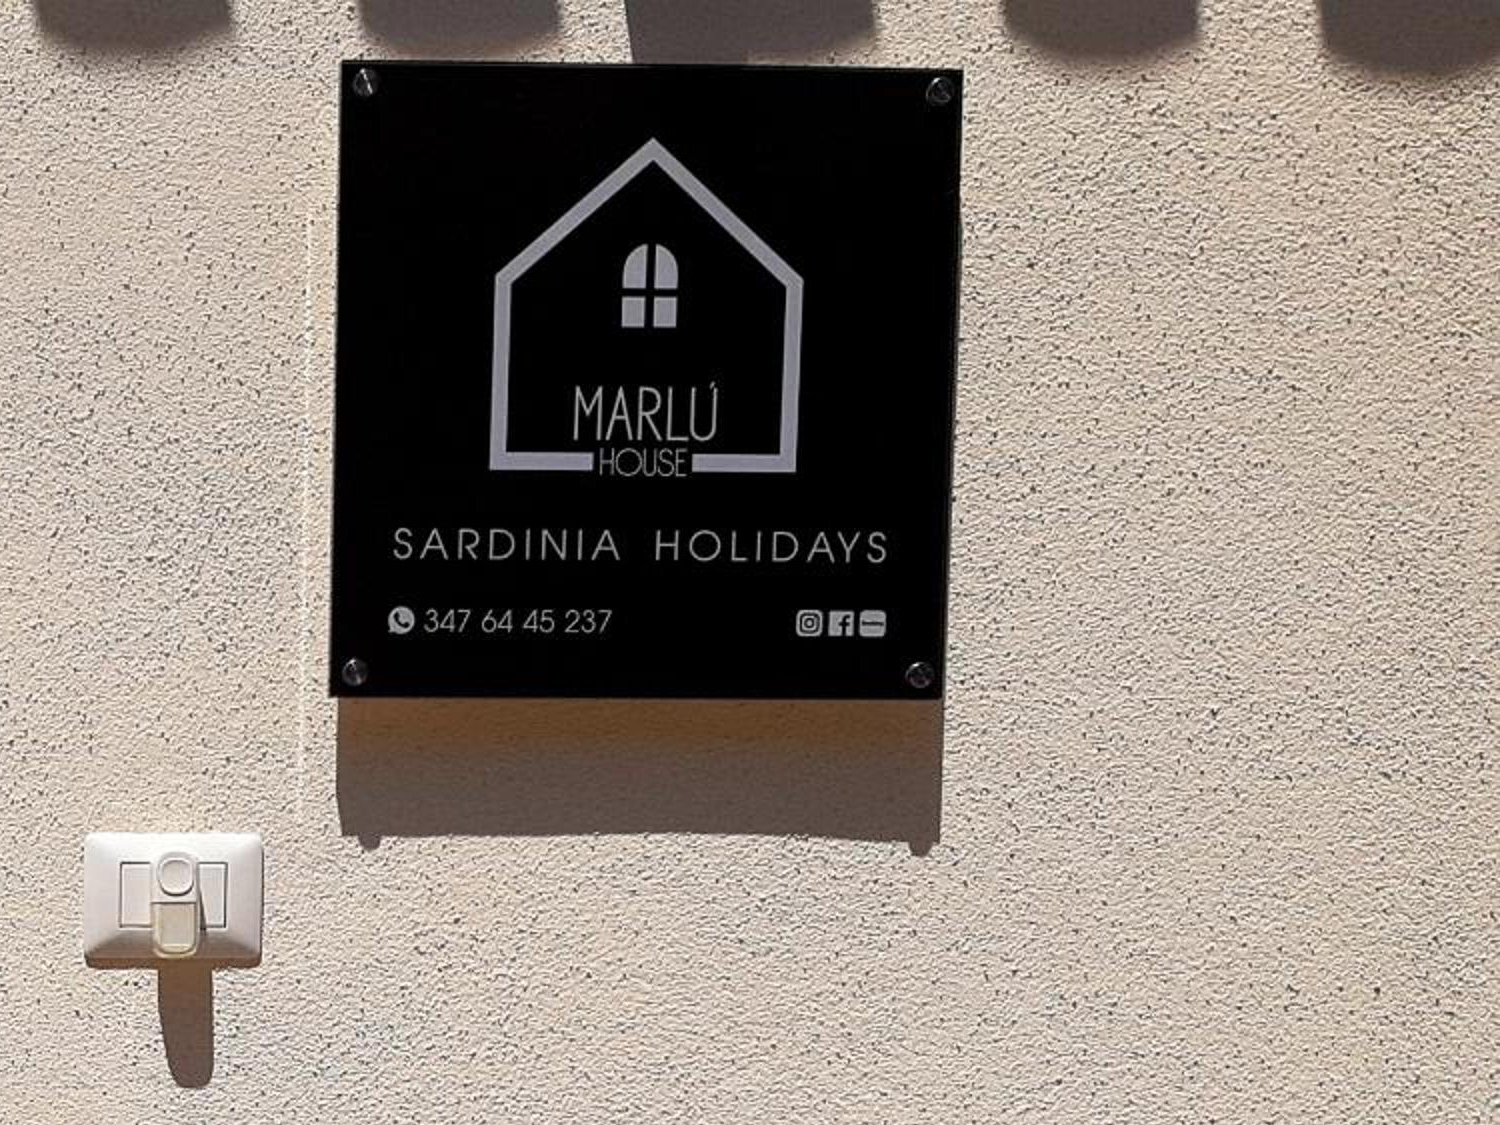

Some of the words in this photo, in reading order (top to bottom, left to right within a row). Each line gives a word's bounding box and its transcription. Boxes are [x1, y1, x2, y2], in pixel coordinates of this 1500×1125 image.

[573, 381, 718, 442] MARLÚ
[599, 447, 688, 477] HOUSE
[393, 527, 620, 561] SARDINIA
[655, 530, 888, 563] HOLIDAYS
[424, 609, 471, 633] 347
[481, 609, 513, 633] 64
[522, 609, 555, 633] 45
[564, 609, 612, 633] 237
